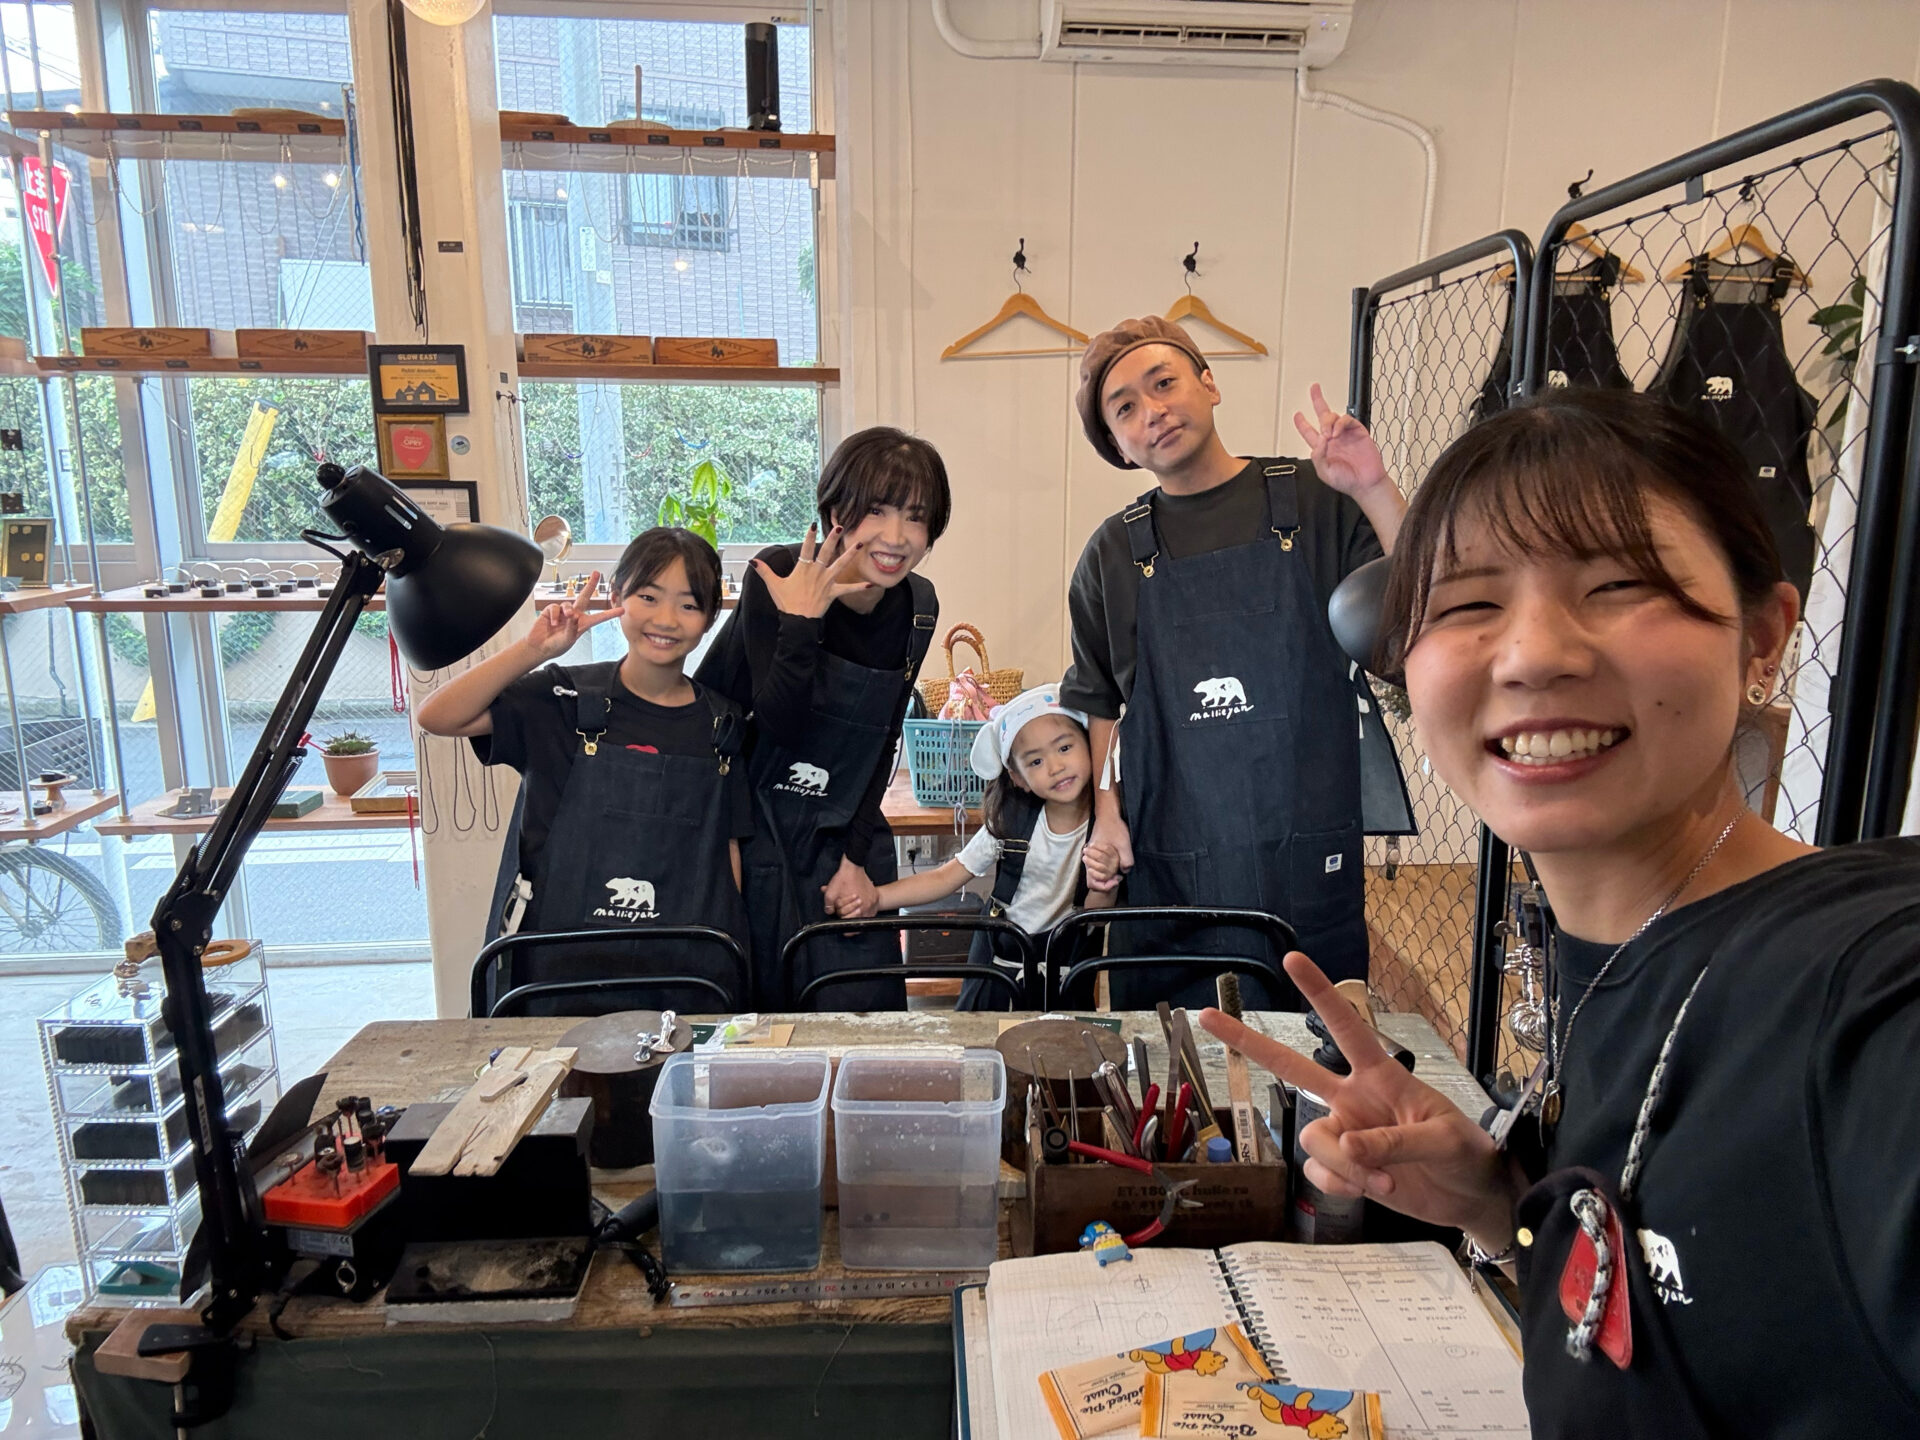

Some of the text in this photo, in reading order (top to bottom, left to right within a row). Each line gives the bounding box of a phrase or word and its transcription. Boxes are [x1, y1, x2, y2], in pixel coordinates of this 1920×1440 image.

[32, 204, 53, 235] STO
[397, 353, 438, 361] GLOW EAST
[1189, 704, 1255, 721] mallieyan
[772, 783, 829, 797] mallieyan
[593, 908, 660, 923] mallieyan
[1083, 1383, 1122, 1404] Crust
[1183, 1413, 1224, 1424] Crust
[1201, 1424, 1257, 1437] Baked
